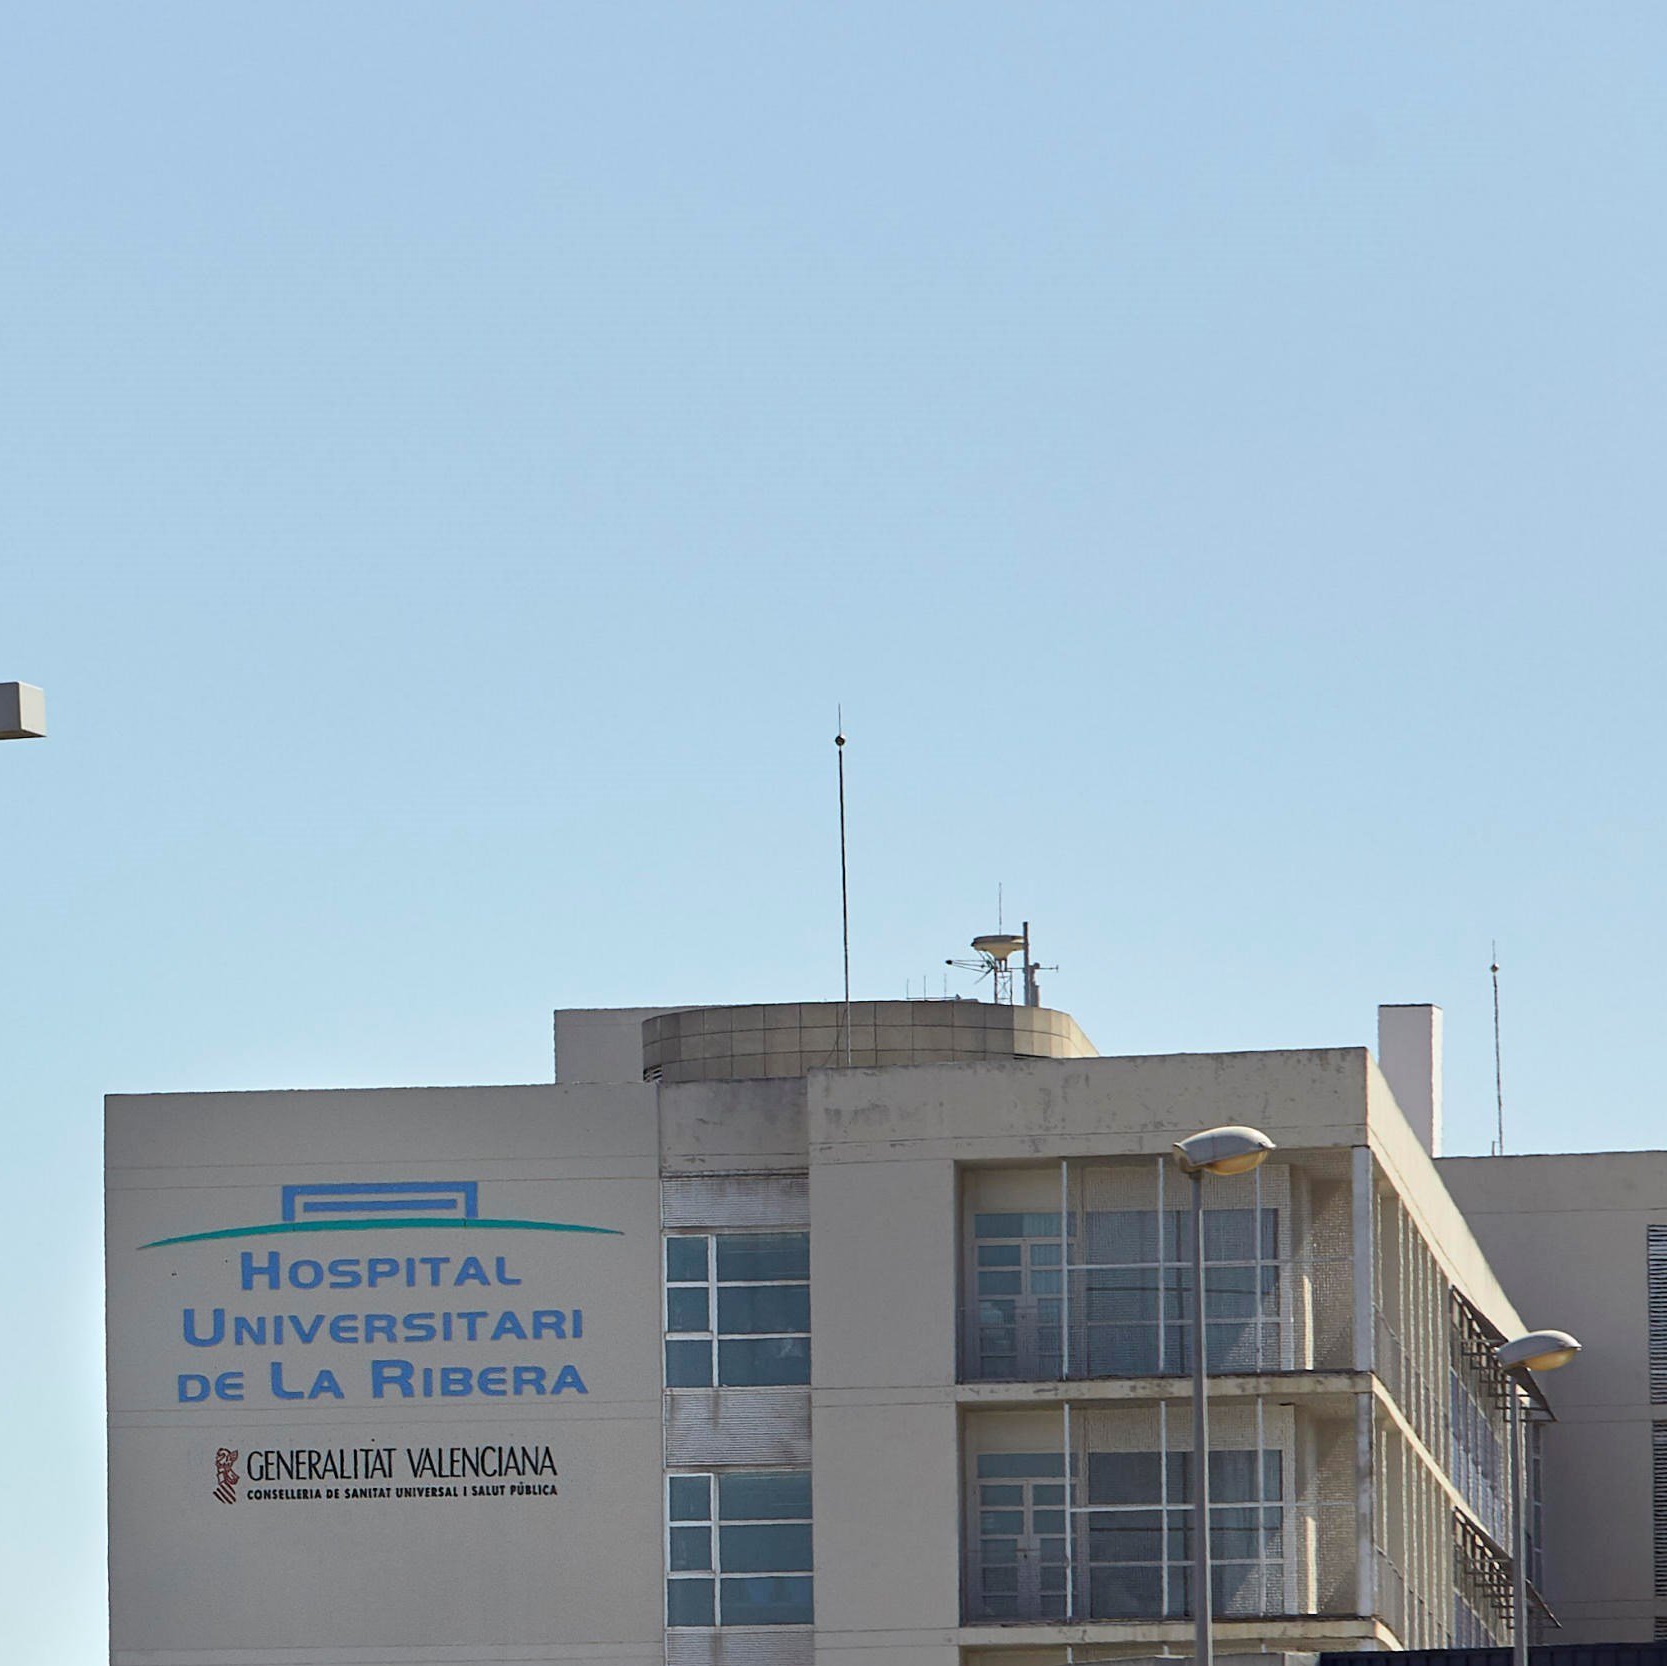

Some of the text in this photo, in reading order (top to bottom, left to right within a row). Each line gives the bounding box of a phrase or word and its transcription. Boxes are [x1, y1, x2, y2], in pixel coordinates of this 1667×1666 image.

[241, 1251, 521, 1290] HOSPITAL
[183, 1308, 582, 1347] UNIVERSITARI
[178, 1360, 587, 1402] DE LA RIBERA
[247, 1446, 557, 1481] GENERALITAT VALENCIANA
[247, 1489, 321, 1500] CONSELLERIA
[327, 1489, 339, 1498] DE
[345, 1488, 391, 1499] SANITAT
[396, 1487, 458, 1497] UNIVERSAL
[472, 1485, 505, 1496] SALUT
[510, 1482, 557, 1495] PÚBLICA
